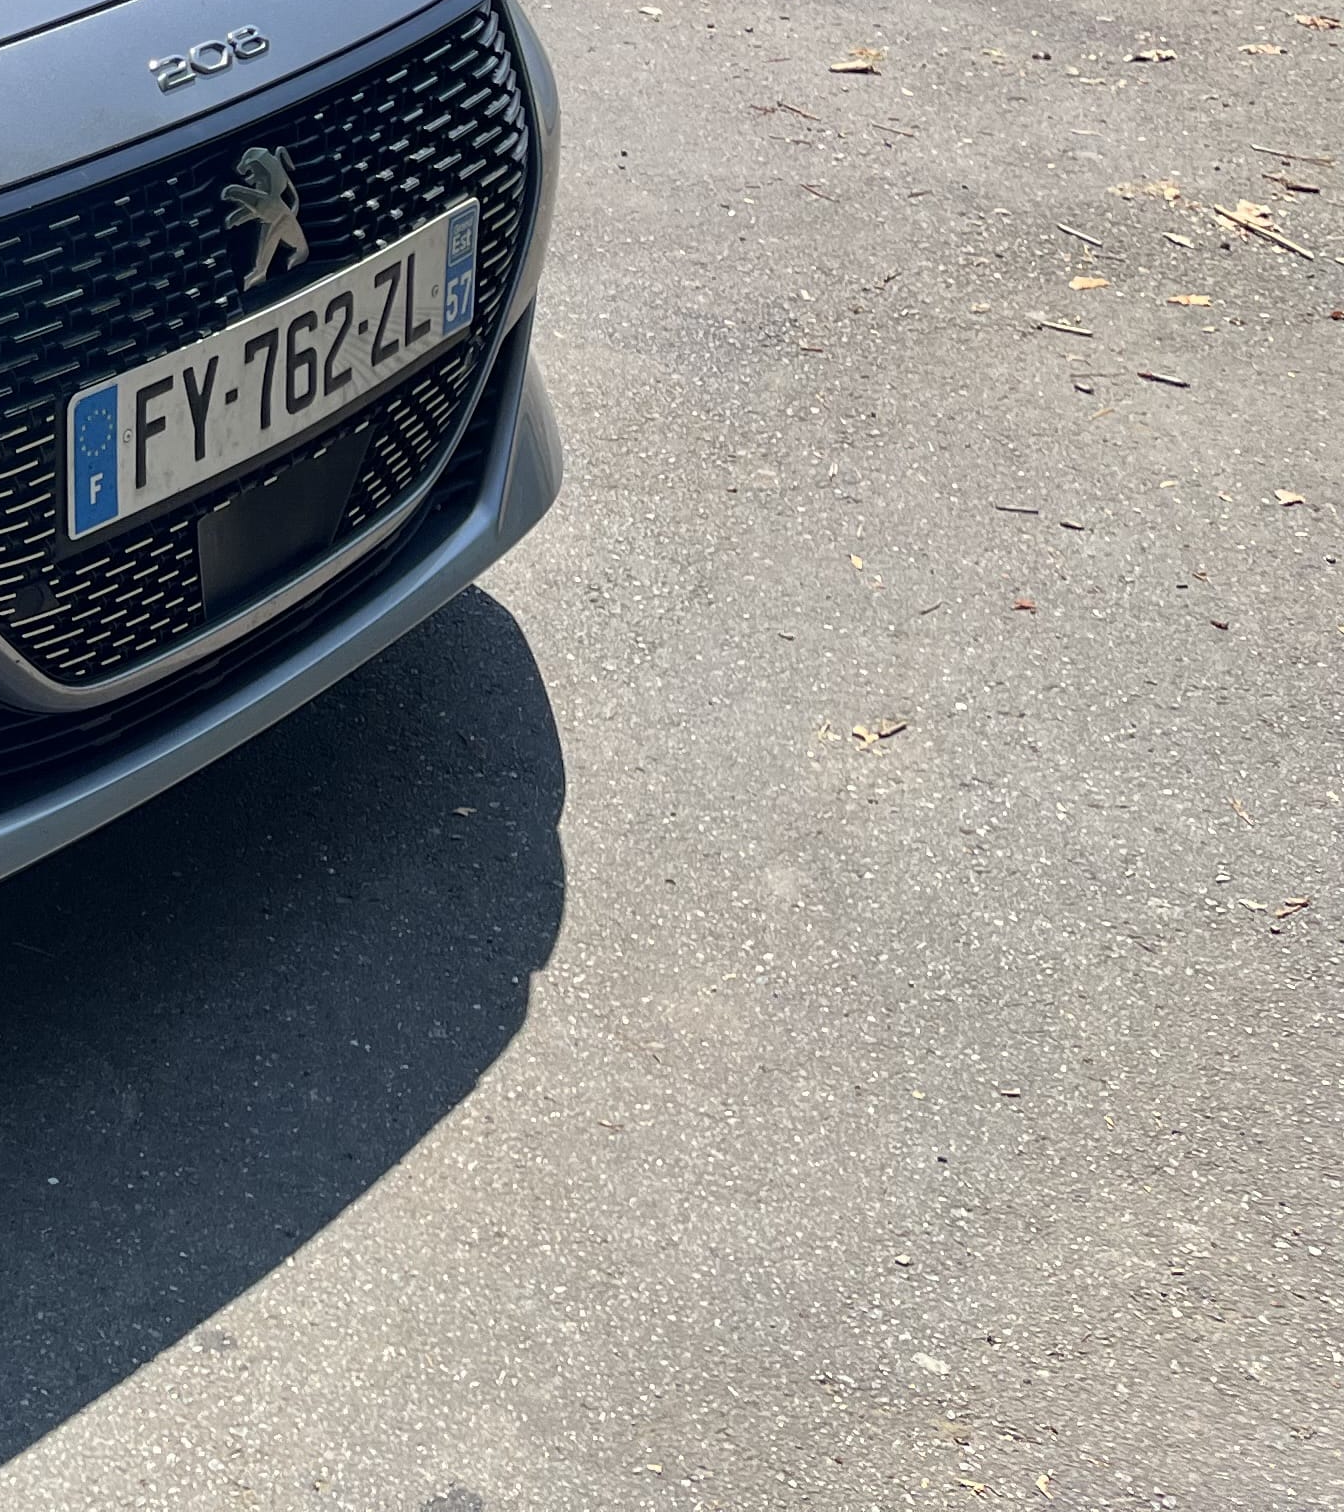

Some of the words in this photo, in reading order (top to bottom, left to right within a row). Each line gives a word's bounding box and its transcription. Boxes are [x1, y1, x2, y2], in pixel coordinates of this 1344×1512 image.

[149, 24, 270, 95] 208
[446, 270, 472, 321] 57
[135, 252, 431, 489] FY-762-ZL
[89, 473, 103, 505] F
